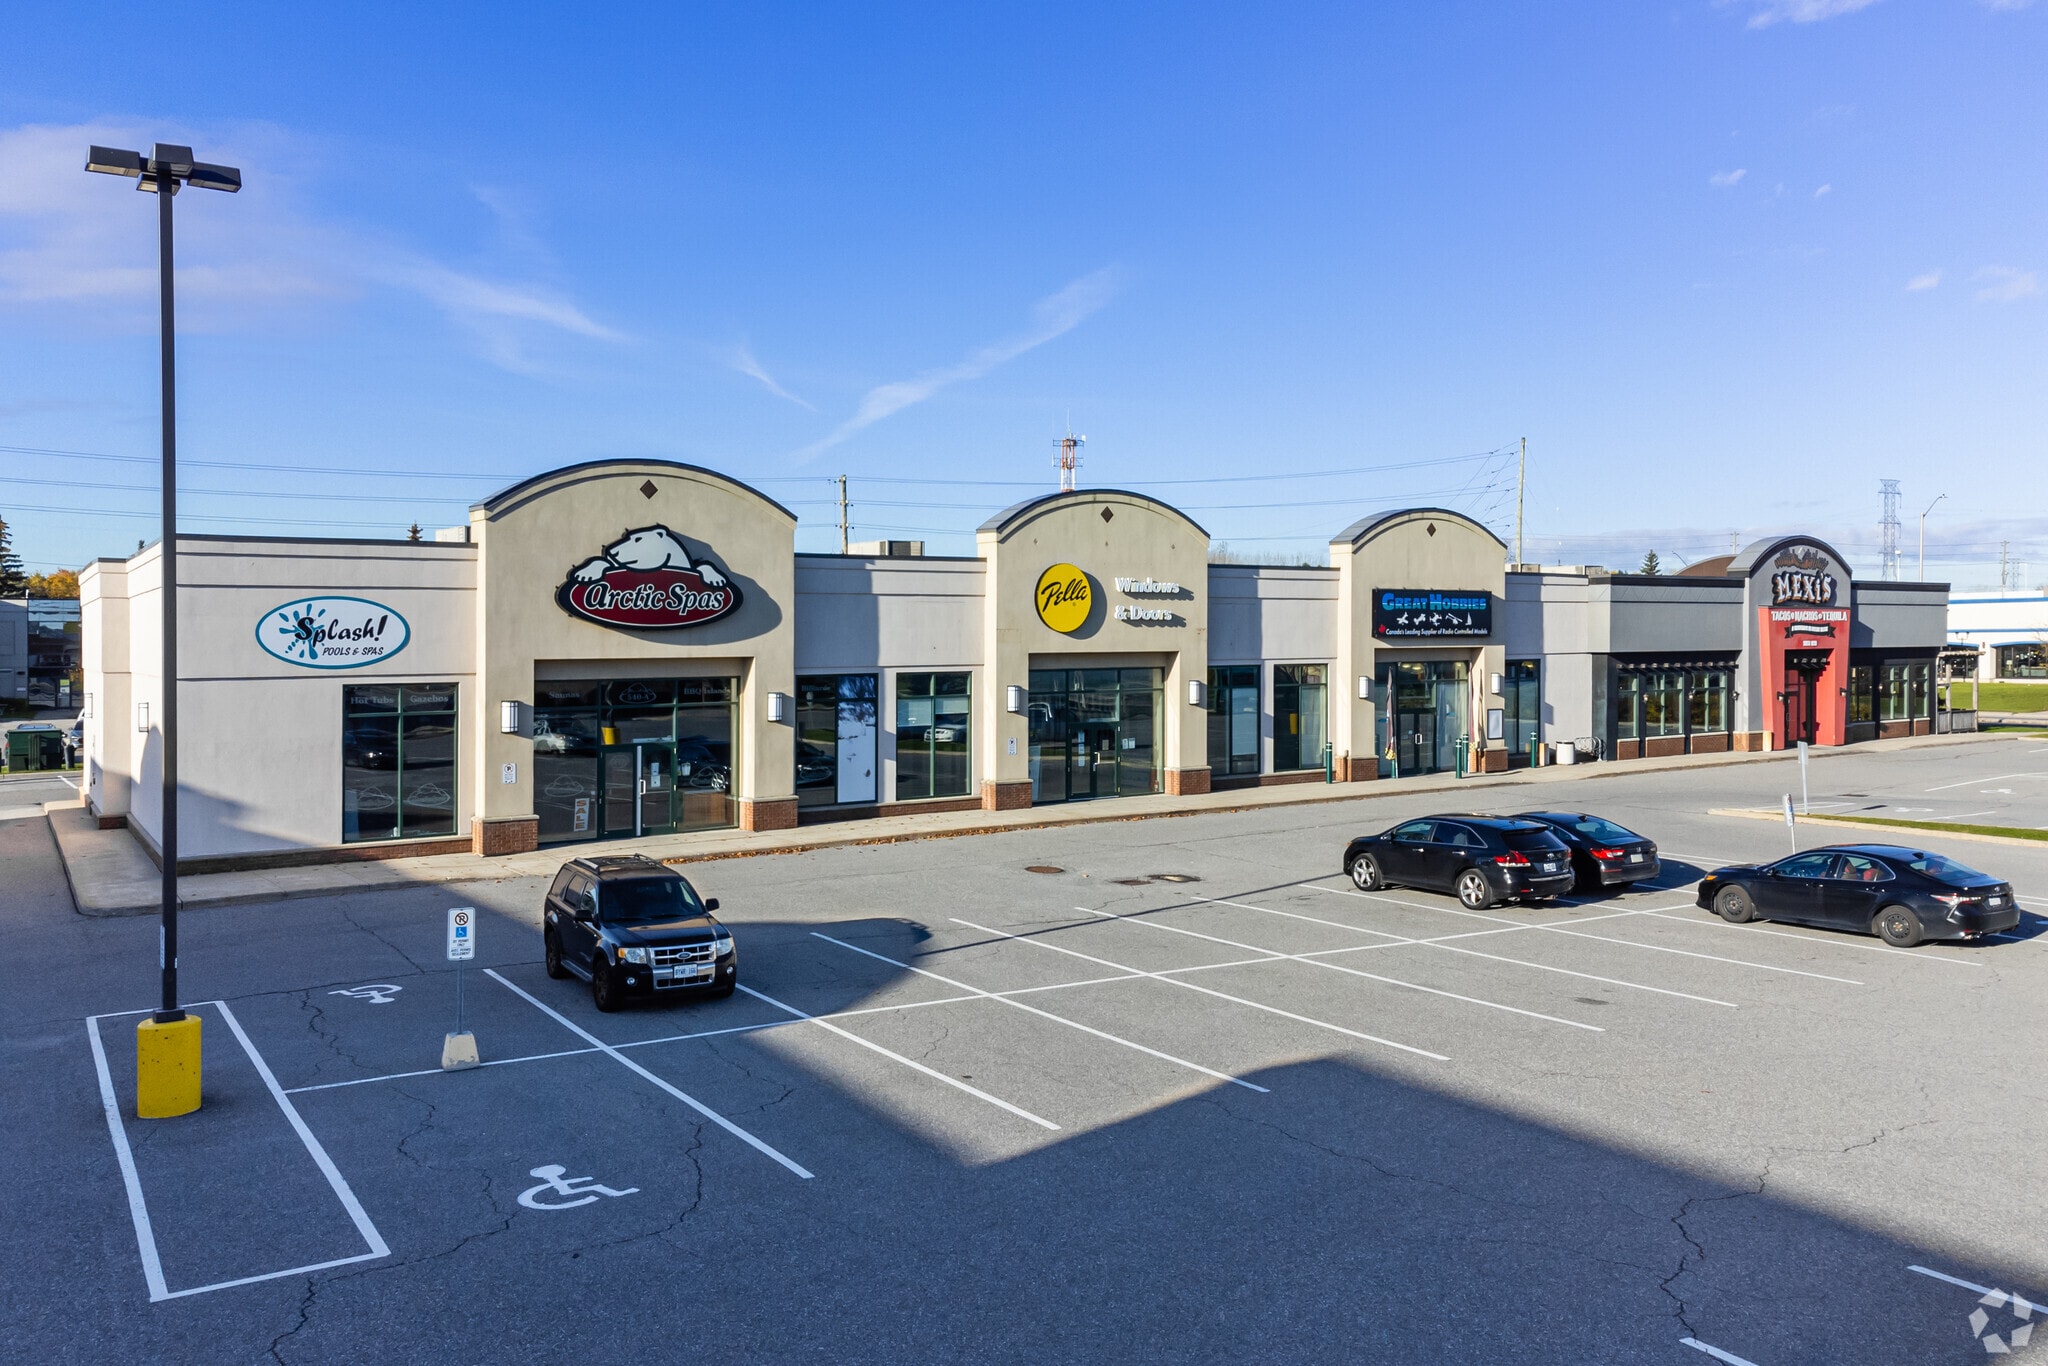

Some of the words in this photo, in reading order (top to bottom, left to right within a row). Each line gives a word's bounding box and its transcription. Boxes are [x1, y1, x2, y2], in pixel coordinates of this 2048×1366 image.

[1114, 577, 1180, 593] Windows
[584, 582, 663, 610] Arctic
[666, 583, 724, 616] Spas
[1041, 578, 1088, 612] Pella
[1114, 604, 1128, 620] &
[1129, 605, 1173, 621] Doors
[1771, 611, 1791, 621] TACOS
[1794, 611, 1818, 622] NACHOS
[1821, 611, 1848, 622] TEQUILA
[294, 614, 389, 648] Splash!
[1405, 628, 1420, 636] Leading
[1421, 628, 1437, 636] Supplier
[322, 647, 350, 656] POOLS
[351, 647, 360, 656] &
[361, 647, 384, 656] SPAS
[410, 695, 449, 703] Gazebos
[575, 800, 587, 830] SALE
